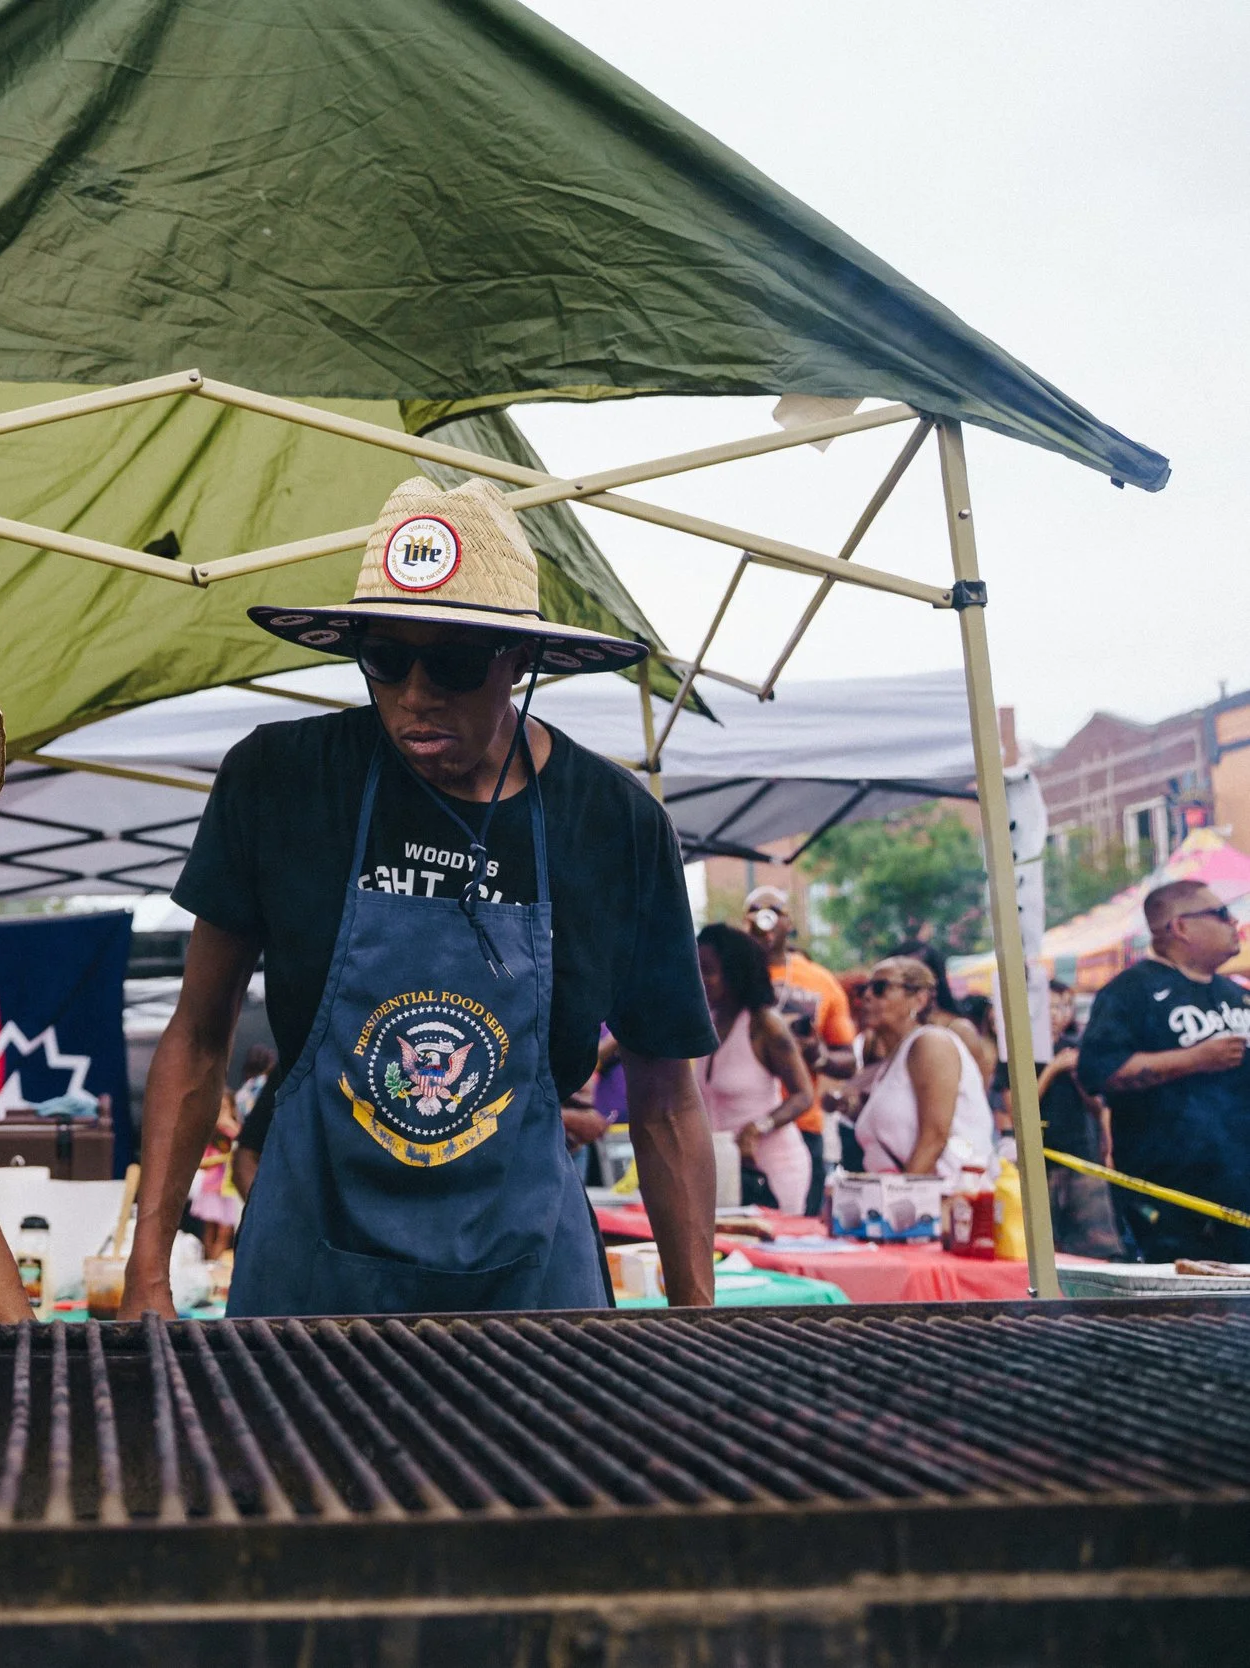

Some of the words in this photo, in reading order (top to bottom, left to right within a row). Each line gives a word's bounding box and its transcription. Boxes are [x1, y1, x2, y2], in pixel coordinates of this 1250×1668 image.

[402, 543, 442, 567] Lite
[405, 842, 499, 877] WOODYS
[358, 865, 445, 898] GHT
[353, 990, 437, 1057] PRESIDENTIAL
[441, 991, 485, 1016] FOOD
[483, 1011, 510, 1069] SERVICE
